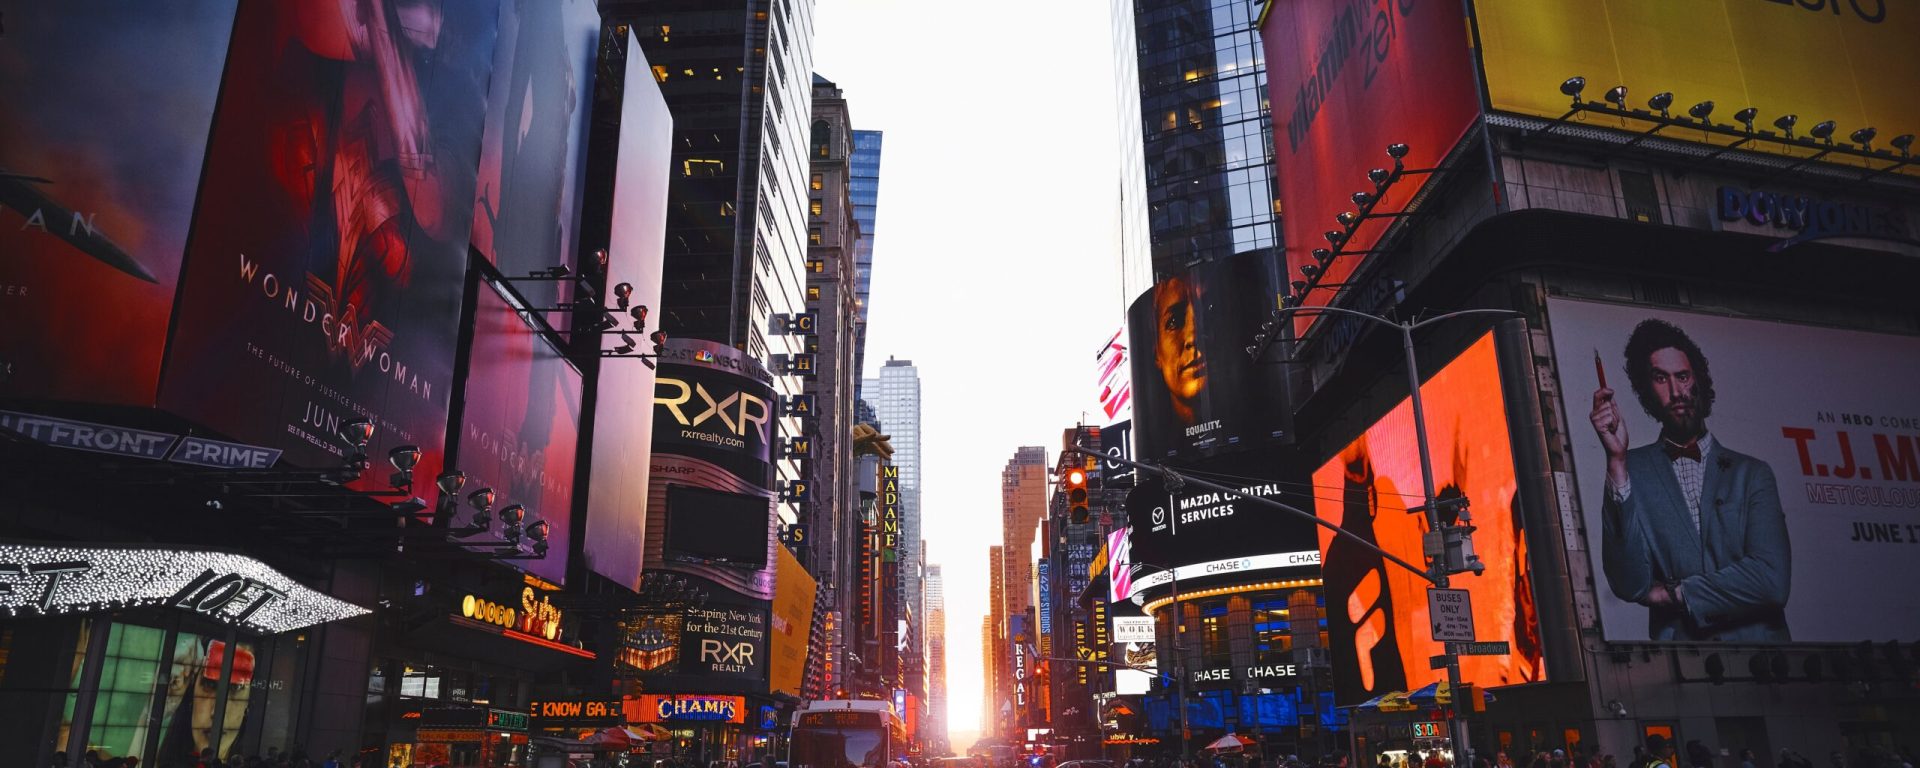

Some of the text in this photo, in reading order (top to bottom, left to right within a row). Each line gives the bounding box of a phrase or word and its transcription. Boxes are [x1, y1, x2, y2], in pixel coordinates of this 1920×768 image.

[1718, 187, 1808, 232] DOW
[240, 253, 431, 400] WONDER WOMAN
[247, 342, 264, 359] THE
[269, 354, 300, 379] FUTURE
[305, 375, 316, 386] OF
[319, 384, 350, 407] JUSTICE
[303, 400, 346, 435] JUN
[654, 377, 768, 446] RXR
[1817, 411, 1836, 423] AN
[1841, 413, 1873, 426] HBO
[794, 315, 812, 543] CHAMPS
[681, 430, 745, 449] rxrrealty.com
[184, 441, 269, 469] PRIME
[470, 423, 569, 499] WONDER WOMAN
[1782, 426, 1920, 482] T.J. M
[650, 464, 696, 475] SHARP
[1180, 492, 1220, 510] MAZDA
[1805, 482, 1920, 509] METICULOU
[884, 466, 897, 547] MADAME
[1181, 504, 1234, 524] SERVICES
[1851, 521, 1904, 543] JUNE
[1206, 561, 1239, 573] CHASE
[1152, 573, 1172, 584] CHASE
[172, 568, 286, 624] LOFT
[1436, 593, 1462, 602] BUSES
[687, 606, 727, 622] Shaping
[728, 610, 747, 622] New
[747, 612, 762, 624] York
[1440, 605, 1459, 614] ONLY
[686, 622, 763, 642] for the 21st Century
[1096, 600, 1105, 646] VICTORY
[1119, 625, 1154, 633] WORK
[700, 639, 754, 666] RXR
[1469, 644, 1507, 655] Broadway
[711, 663, 746, 673] REALTY
[1015, 643, 1025, 706] REGAL
[1195, 668, 1231, 682] CHASE
[1247, 664, 1297, 678] CHASE
[543, 702, 582, 717] KNOW
[586, 702, 620, 717] GAE
[658, 699, 736, 718] CHAMPS
[1415, 723, 1440, 737] SODA
